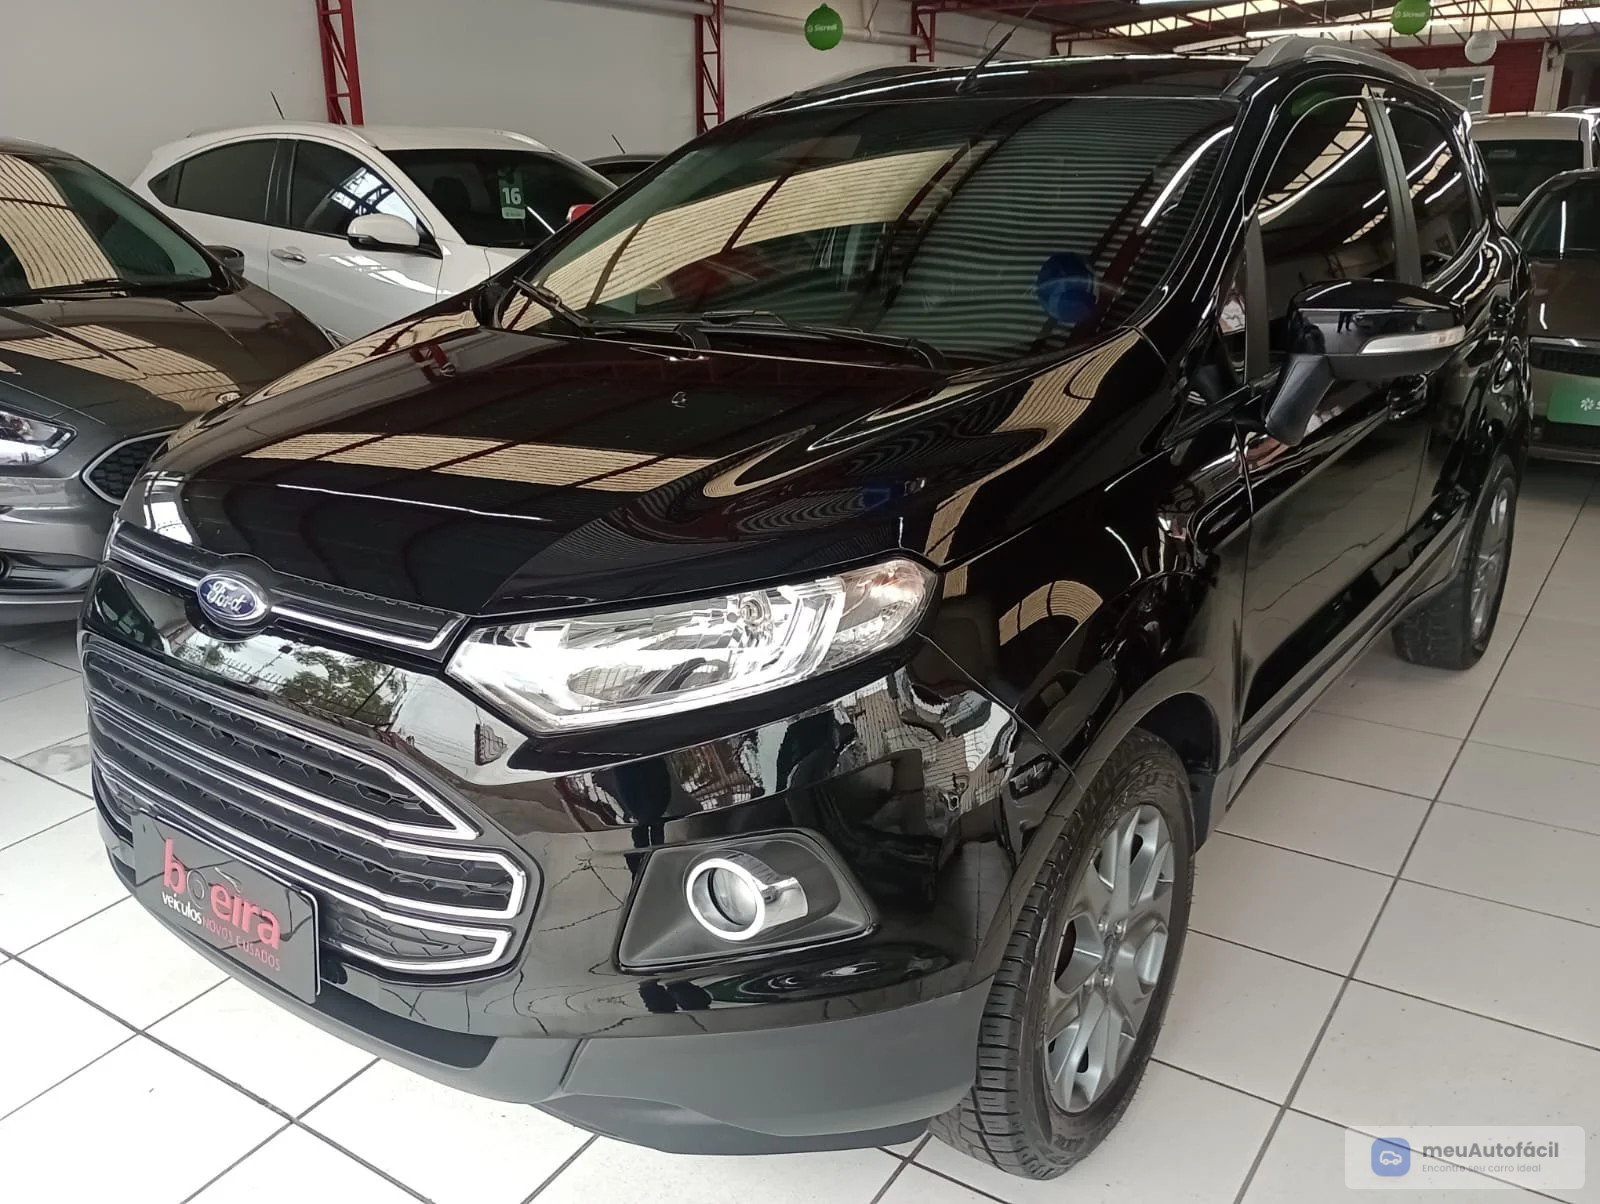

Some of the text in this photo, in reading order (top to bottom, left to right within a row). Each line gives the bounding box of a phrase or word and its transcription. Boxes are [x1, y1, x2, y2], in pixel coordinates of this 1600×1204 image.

[502, 187, 522, 205] 16
[206, 580, 247, 612] Ford
[202, 916, 233, 943] NOVOS
